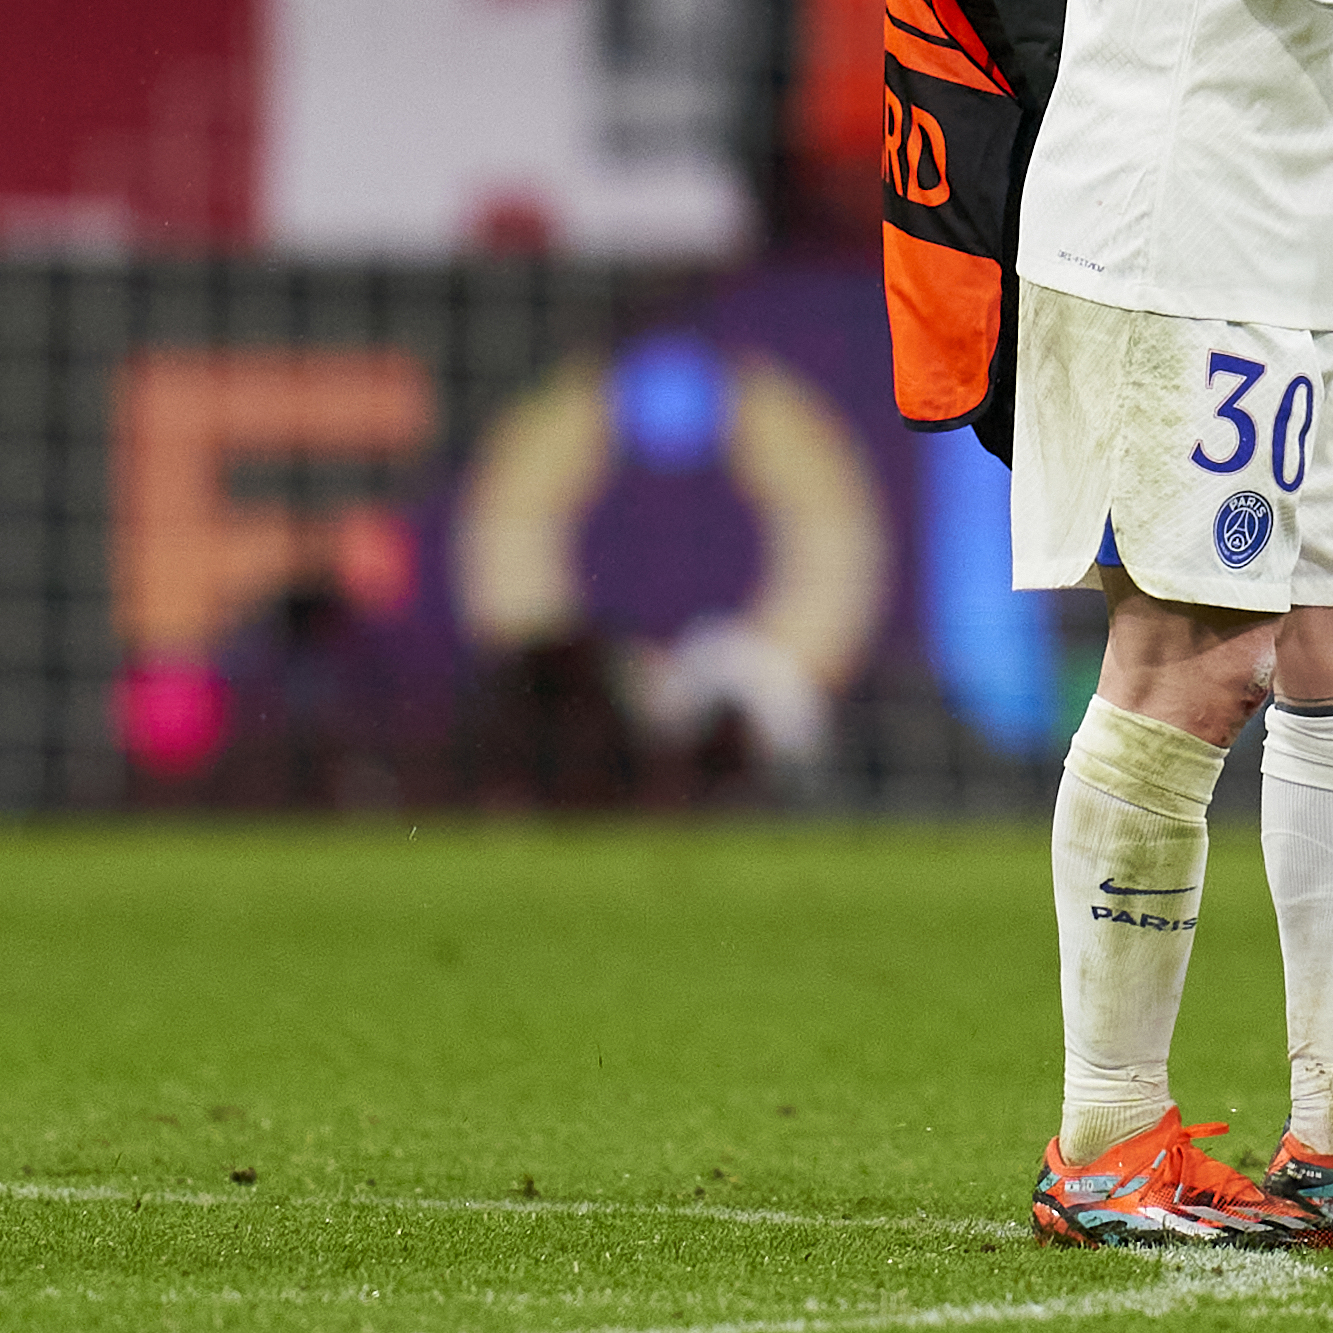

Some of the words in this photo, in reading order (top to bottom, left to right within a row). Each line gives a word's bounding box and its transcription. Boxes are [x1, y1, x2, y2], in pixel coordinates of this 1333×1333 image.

[881, 83, 951, 207] RD
[1190, 349, 1314, 494] 30
[1229, 496, 1267, 518] PARIS
[1091, 905, 1199, 932] PARIS
